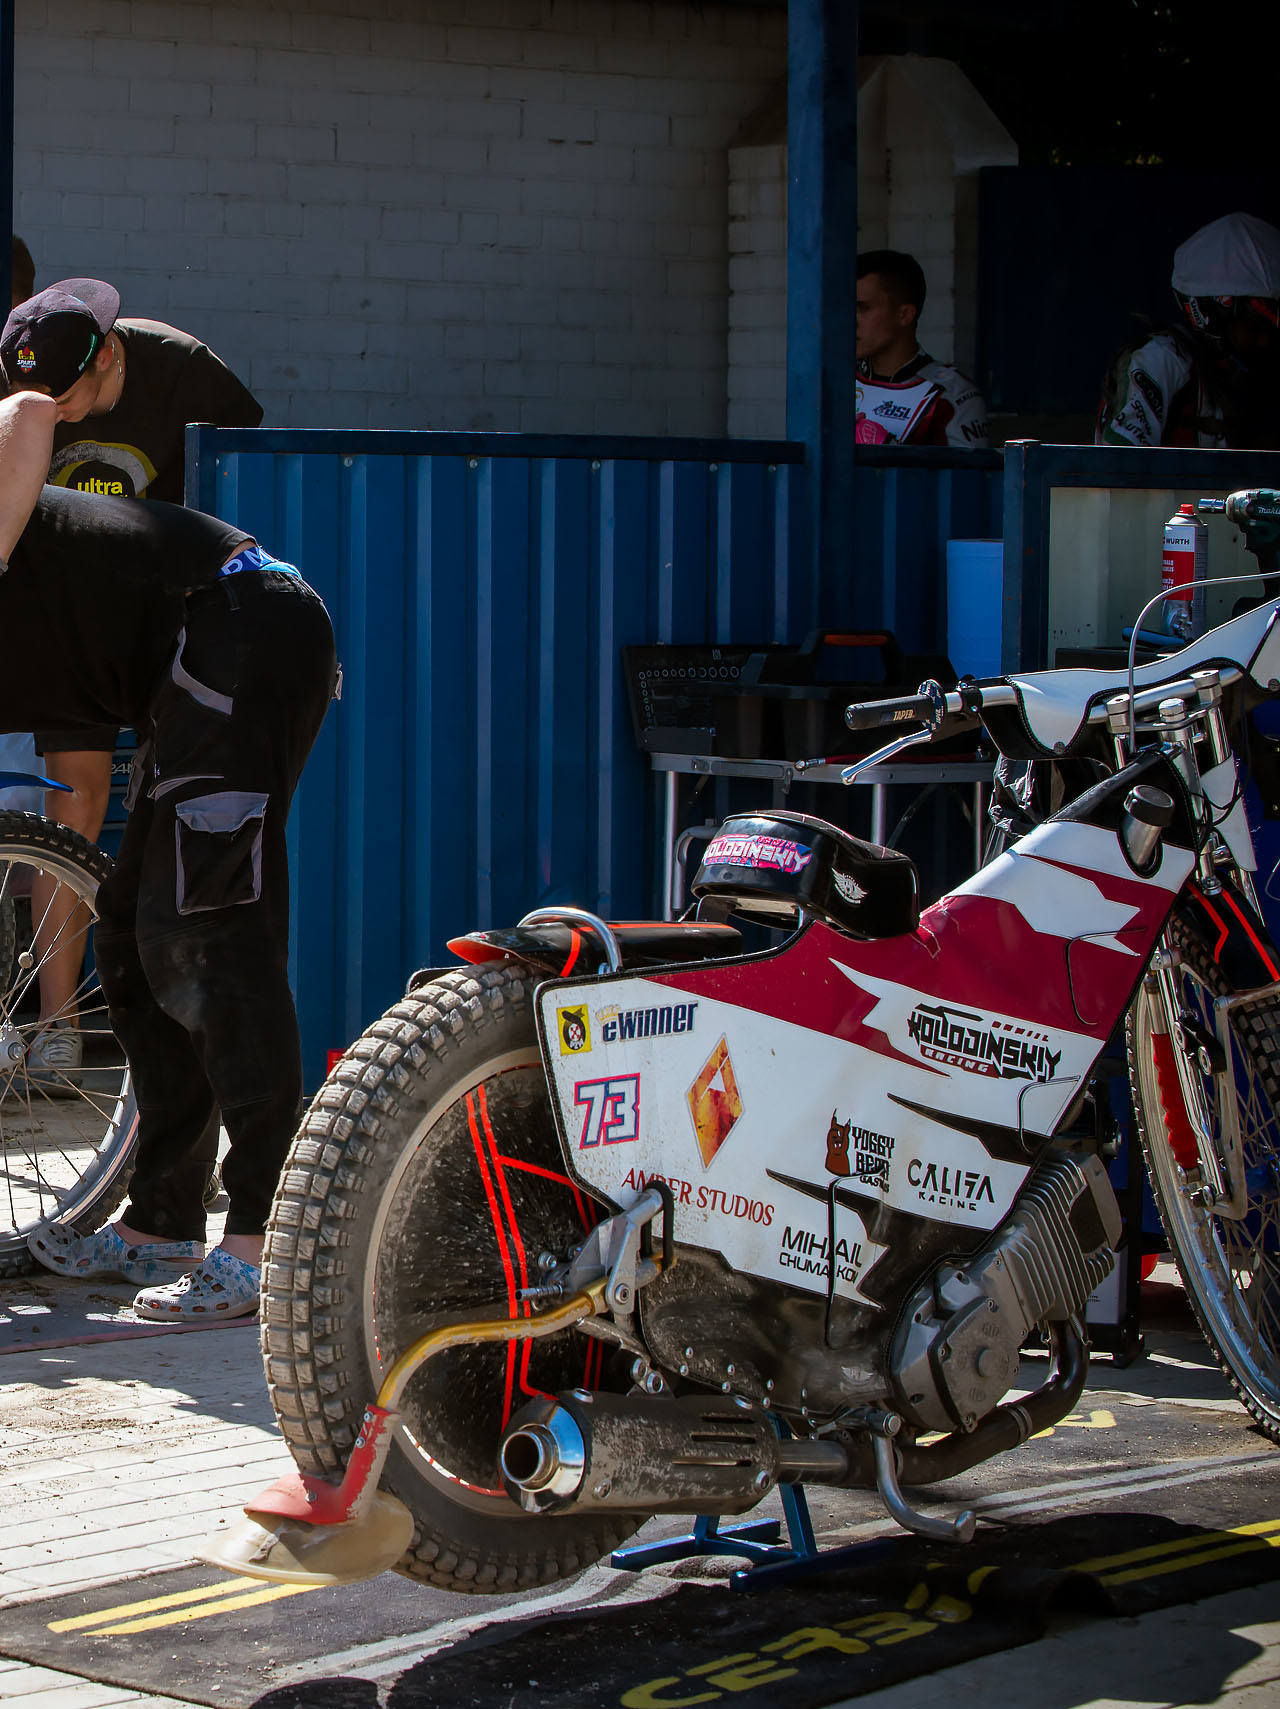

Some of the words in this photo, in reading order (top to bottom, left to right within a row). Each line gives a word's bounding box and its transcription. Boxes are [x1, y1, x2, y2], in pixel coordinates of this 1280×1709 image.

[77, 477, 123, 496] ultra
[574, 1072, 641, 1150] 73
[696, 1185, 775, 1227] STUDIOS
[918, 1191, 977, 1212] RACING
[782, 1225, 862, 1268] MIHAIL
